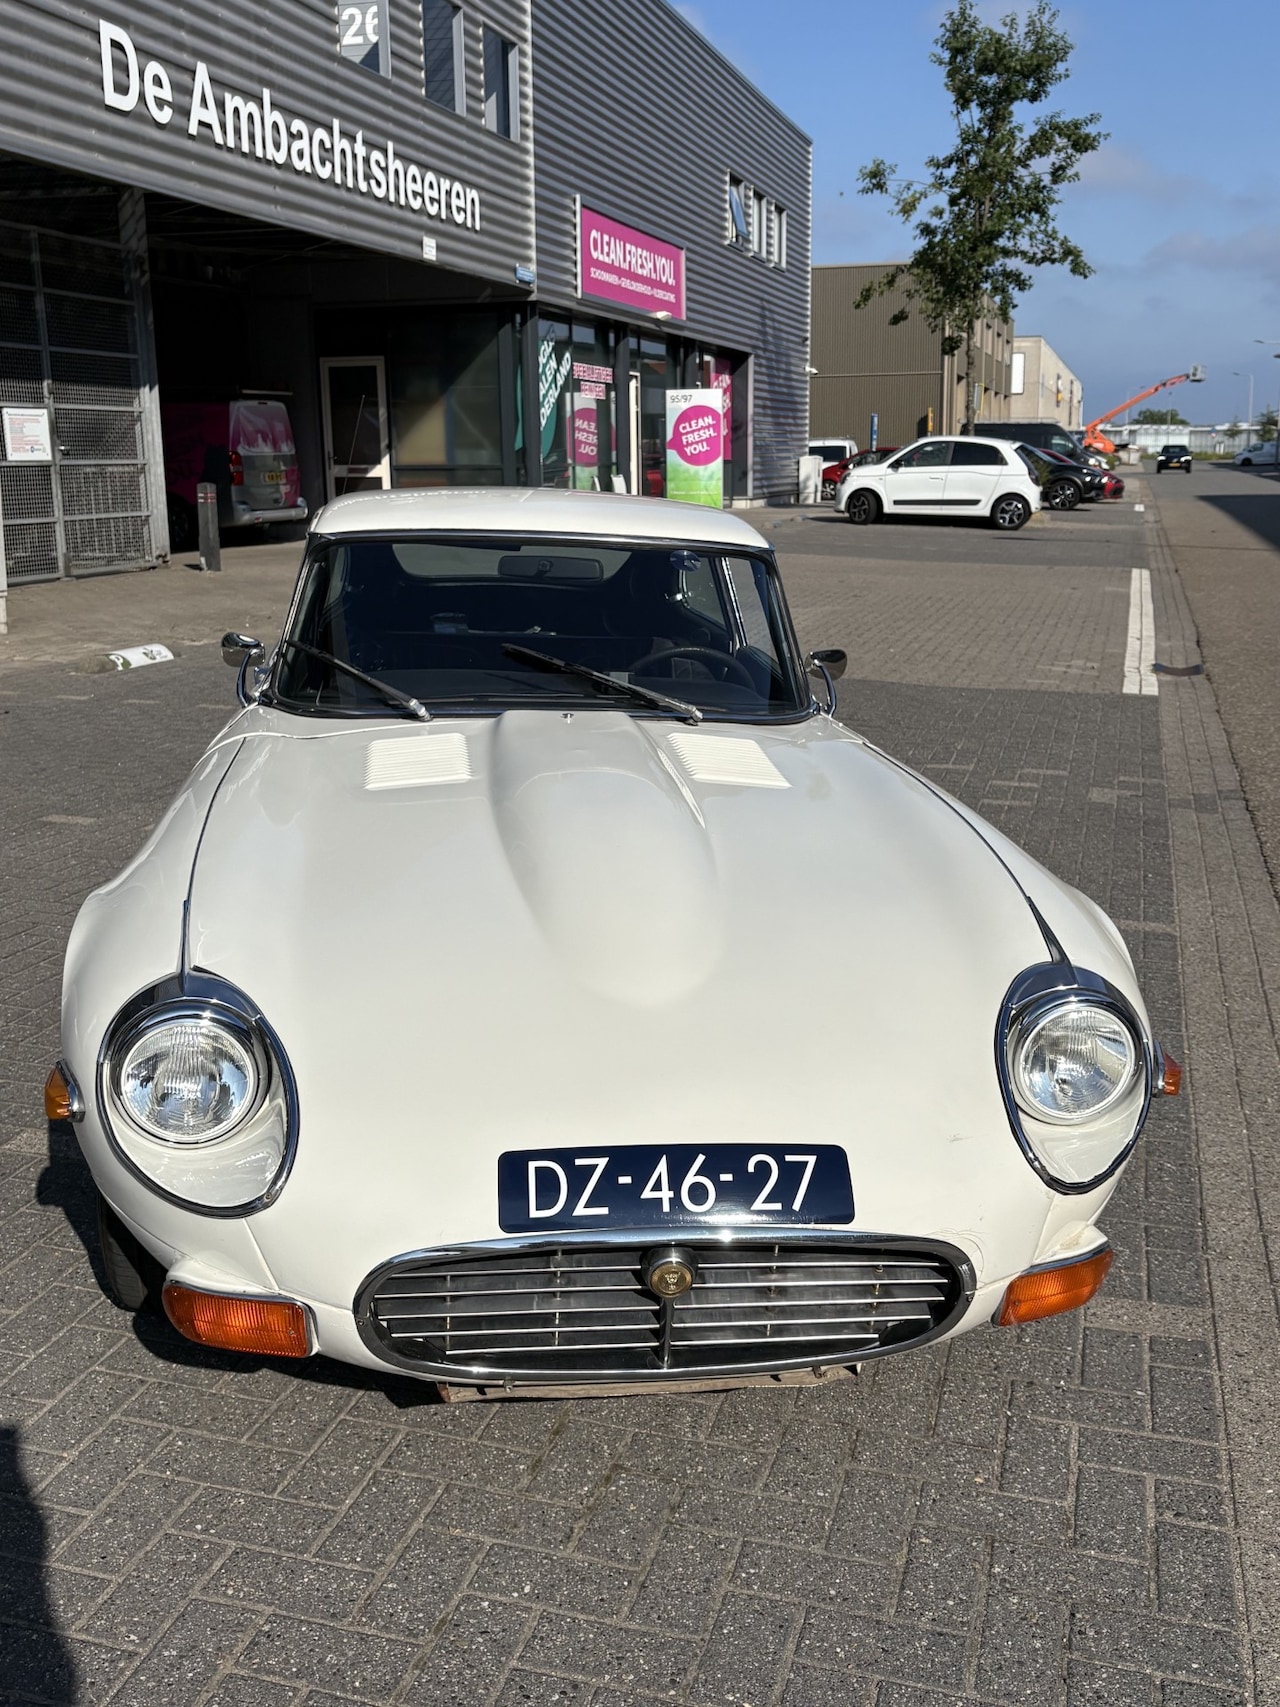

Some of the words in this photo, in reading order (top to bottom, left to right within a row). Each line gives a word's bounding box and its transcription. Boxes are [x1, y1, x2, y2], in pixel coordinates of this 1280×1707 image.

[99, 19, 174, 124] De
[188, 61, 480, 231] Ambachtsheeren
[540, 352, 571, 431] DERLAND
[670, 394, 692, 404] 95/97
[679, 415, 716, 433] CLEAN.
[682, 427, 717, 445] FRESH.
[684, 442, 710, 456] YOU.
[528, 1153, 818, 1219] DZ-46-27
